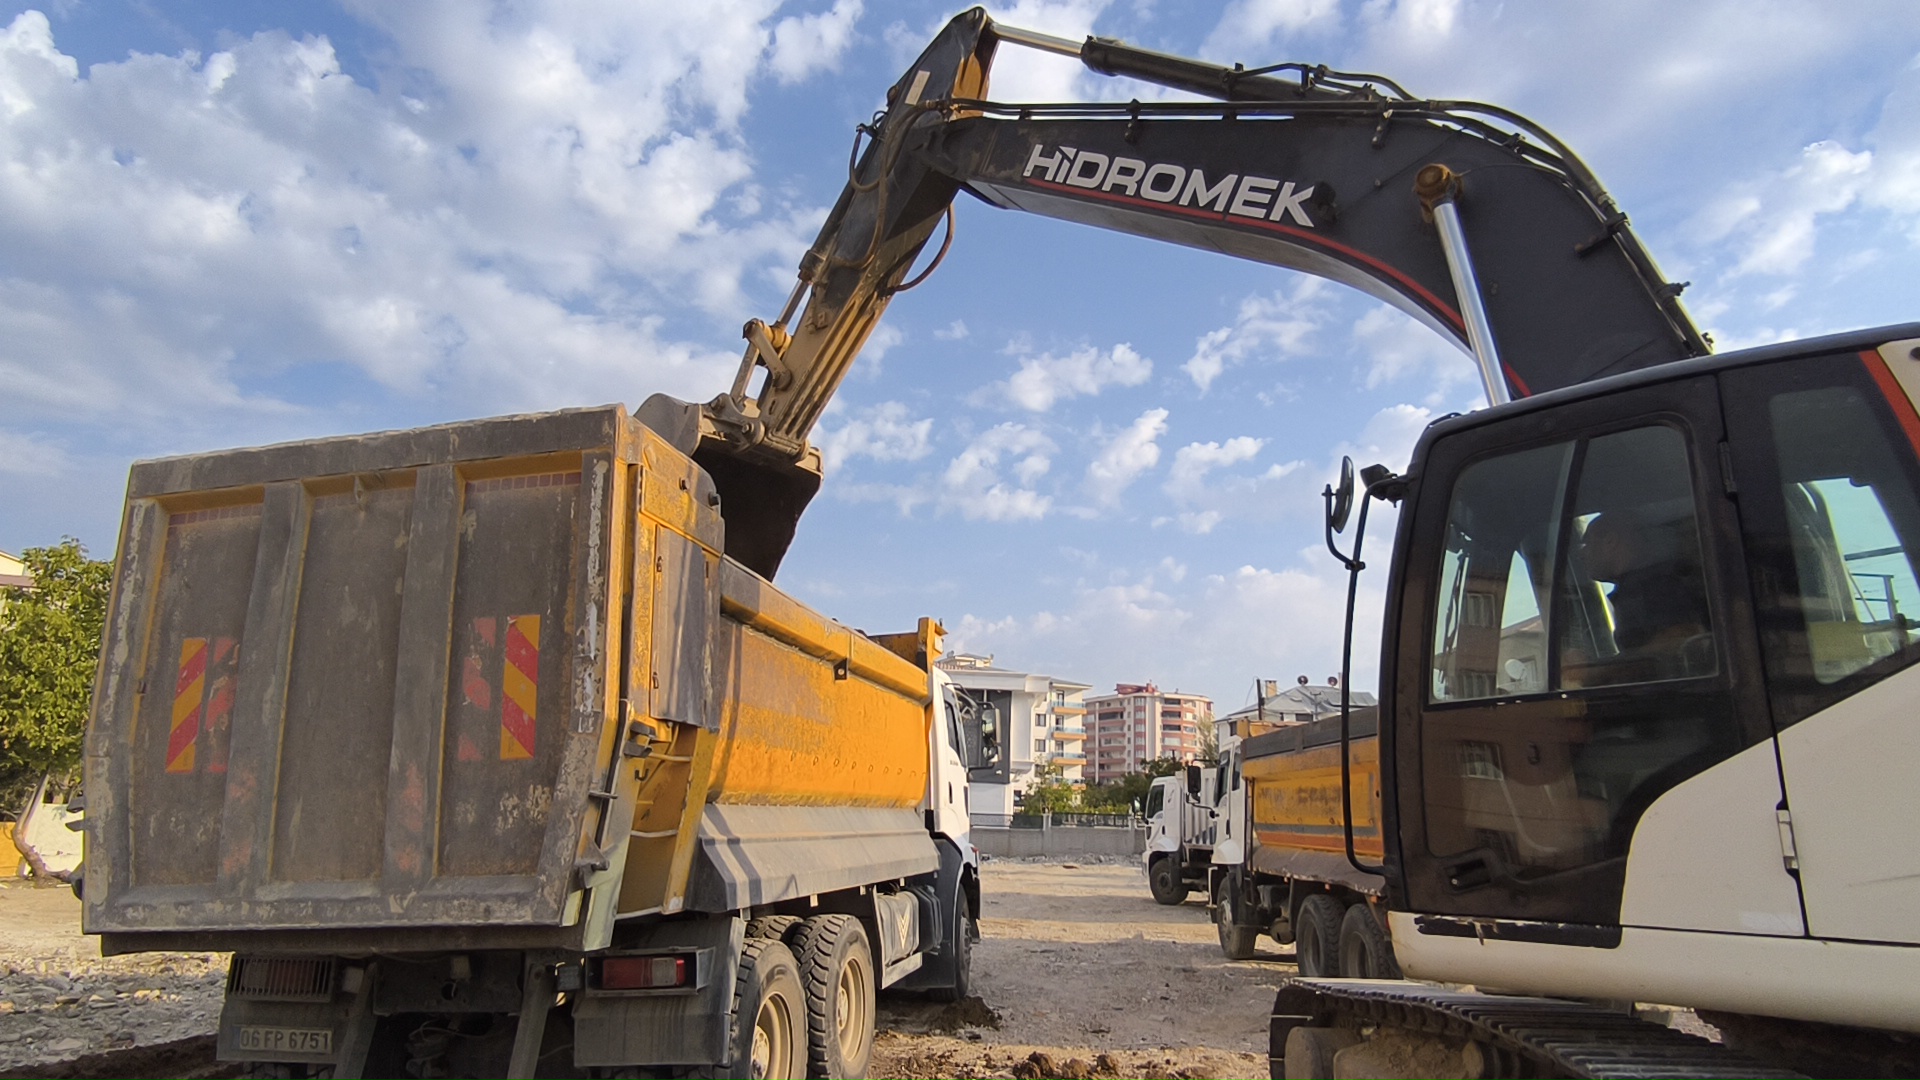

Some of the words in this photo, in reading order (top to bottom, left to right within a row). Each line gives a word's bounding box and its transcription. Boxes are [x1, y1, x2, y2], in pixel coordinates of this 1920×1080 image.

[240, 1030, 260, 1048] 06
[264, 1030, 284, 1049] FP
[288, 1031, 329, 1050] 6751
